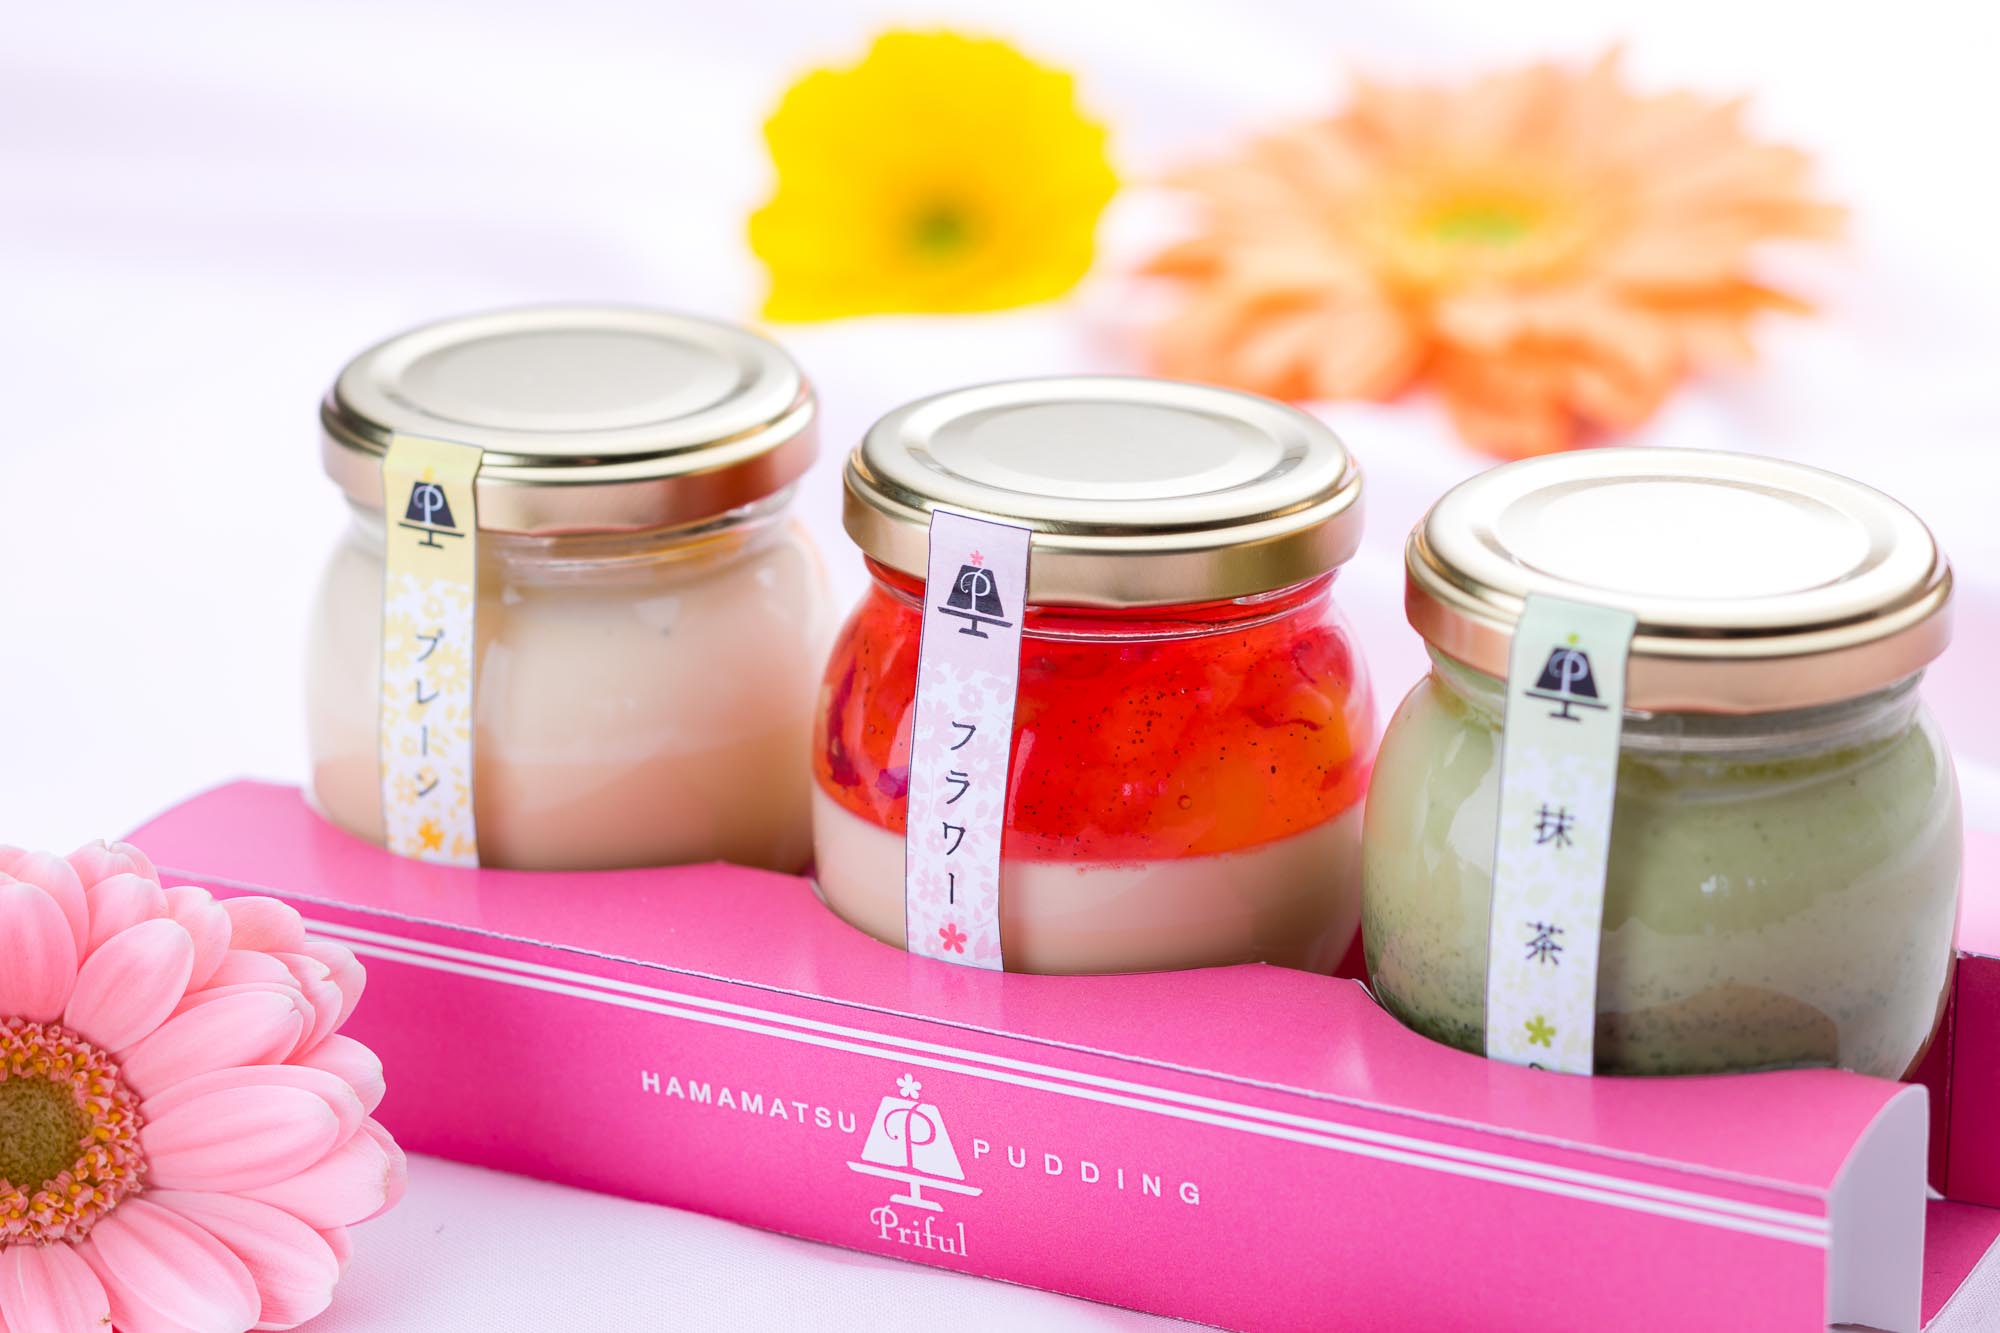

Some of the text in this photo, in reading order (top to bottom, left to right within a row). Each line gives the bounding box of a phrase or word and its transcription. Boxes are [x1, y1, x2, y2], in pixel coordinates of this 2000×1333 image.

[942, 720, 977, 905] フラワー
[1525, 804, 1575, 965] 抹茶
[640, 1069, 1202, 1206] HAMAMATSU PUDDING
[869, 1204, 969, 1258] Priful
